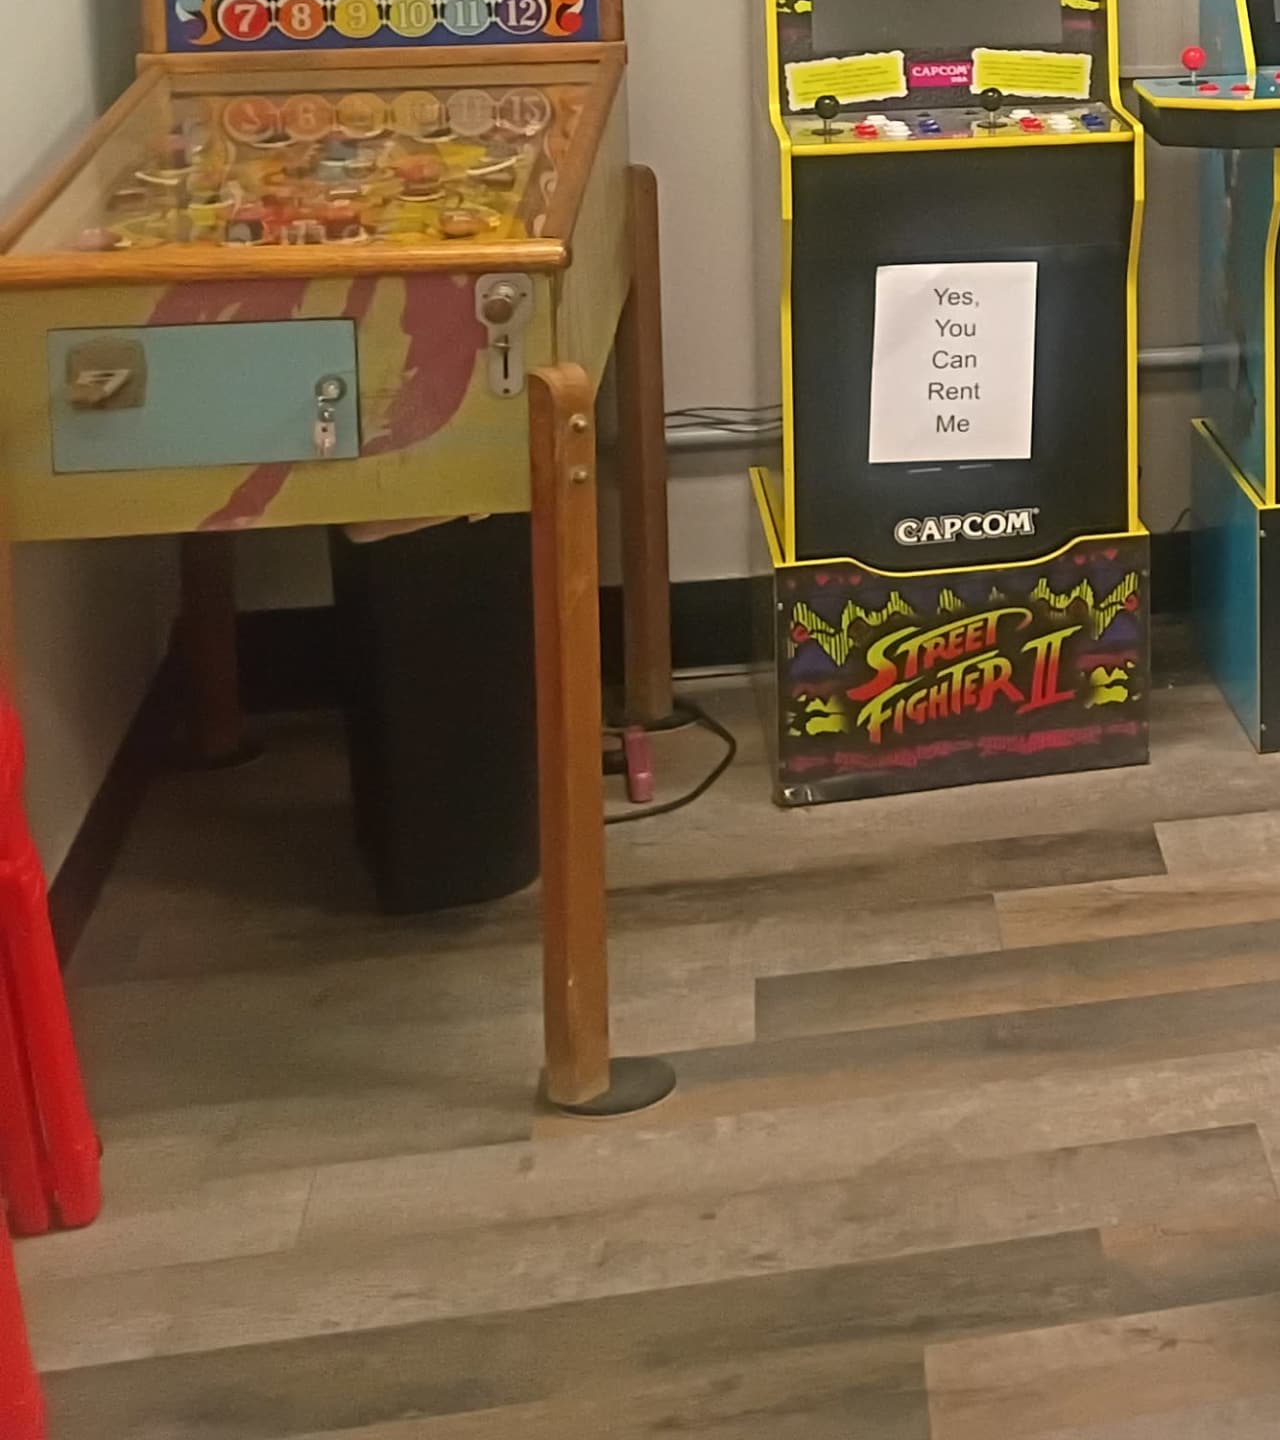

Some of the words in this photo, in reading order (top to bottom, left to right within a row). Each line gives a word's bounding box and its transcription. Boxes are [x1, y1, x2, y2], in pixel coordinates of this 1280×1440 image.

[233, 4, 258, 34] 7
[290, 2, 313, 32] 8
[348, 2, 368, 31] 9
[398, 0, 428, 28] 10
[453, 0, 483, 27] 11
[911, 64, 970, 77] CAPCOM
[933, 287, 980, 308] Yes,
[935, 319, 977, 338] You
[932, 350, 978, 370] Can
[927, 382, 981, 401] Rent
[935, 414, 971, 434] Me
[895, 509, 1036, 545] CAPCOM
[847, 606, 1034, 701] STREET
[856, 650, 1025, 744] FIGHTER
[1015, 624, 1084, 714] II
